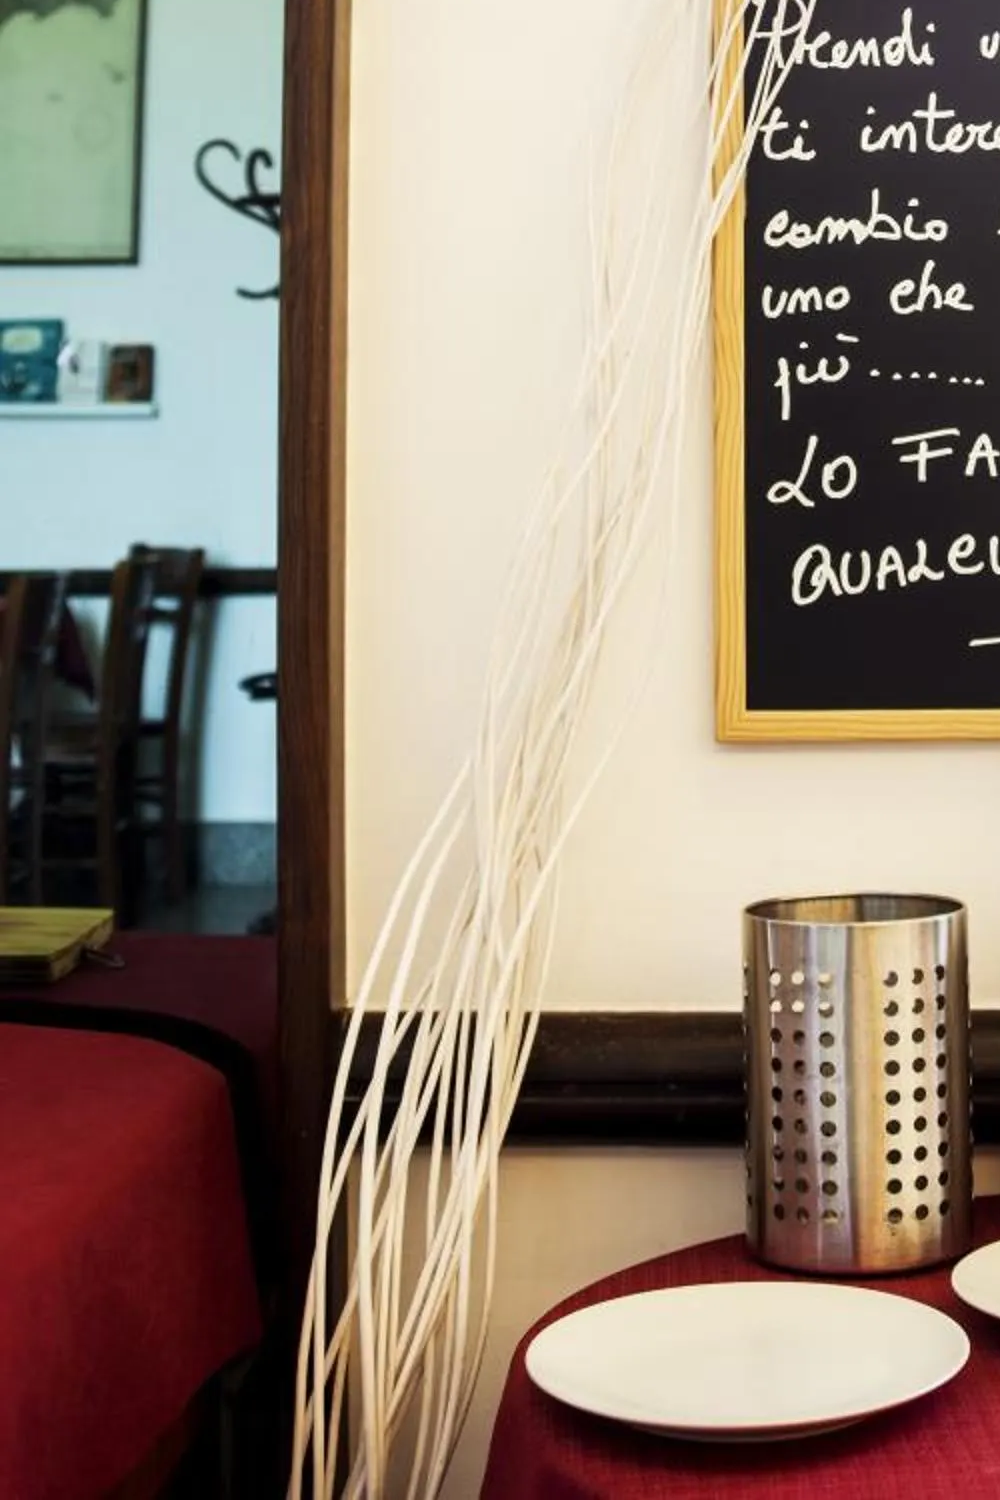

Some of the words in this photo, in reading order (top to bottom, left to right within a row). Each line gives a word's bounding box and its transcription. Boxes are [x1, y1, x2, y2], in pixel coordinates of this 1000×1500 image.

[757, 106, 816, 161] ti
[763, 188, 949, 249] cambio
[761, 285, 851, 318] uno
[889, 260, 974, 316] che
[766, 434, 858, 508] LO
